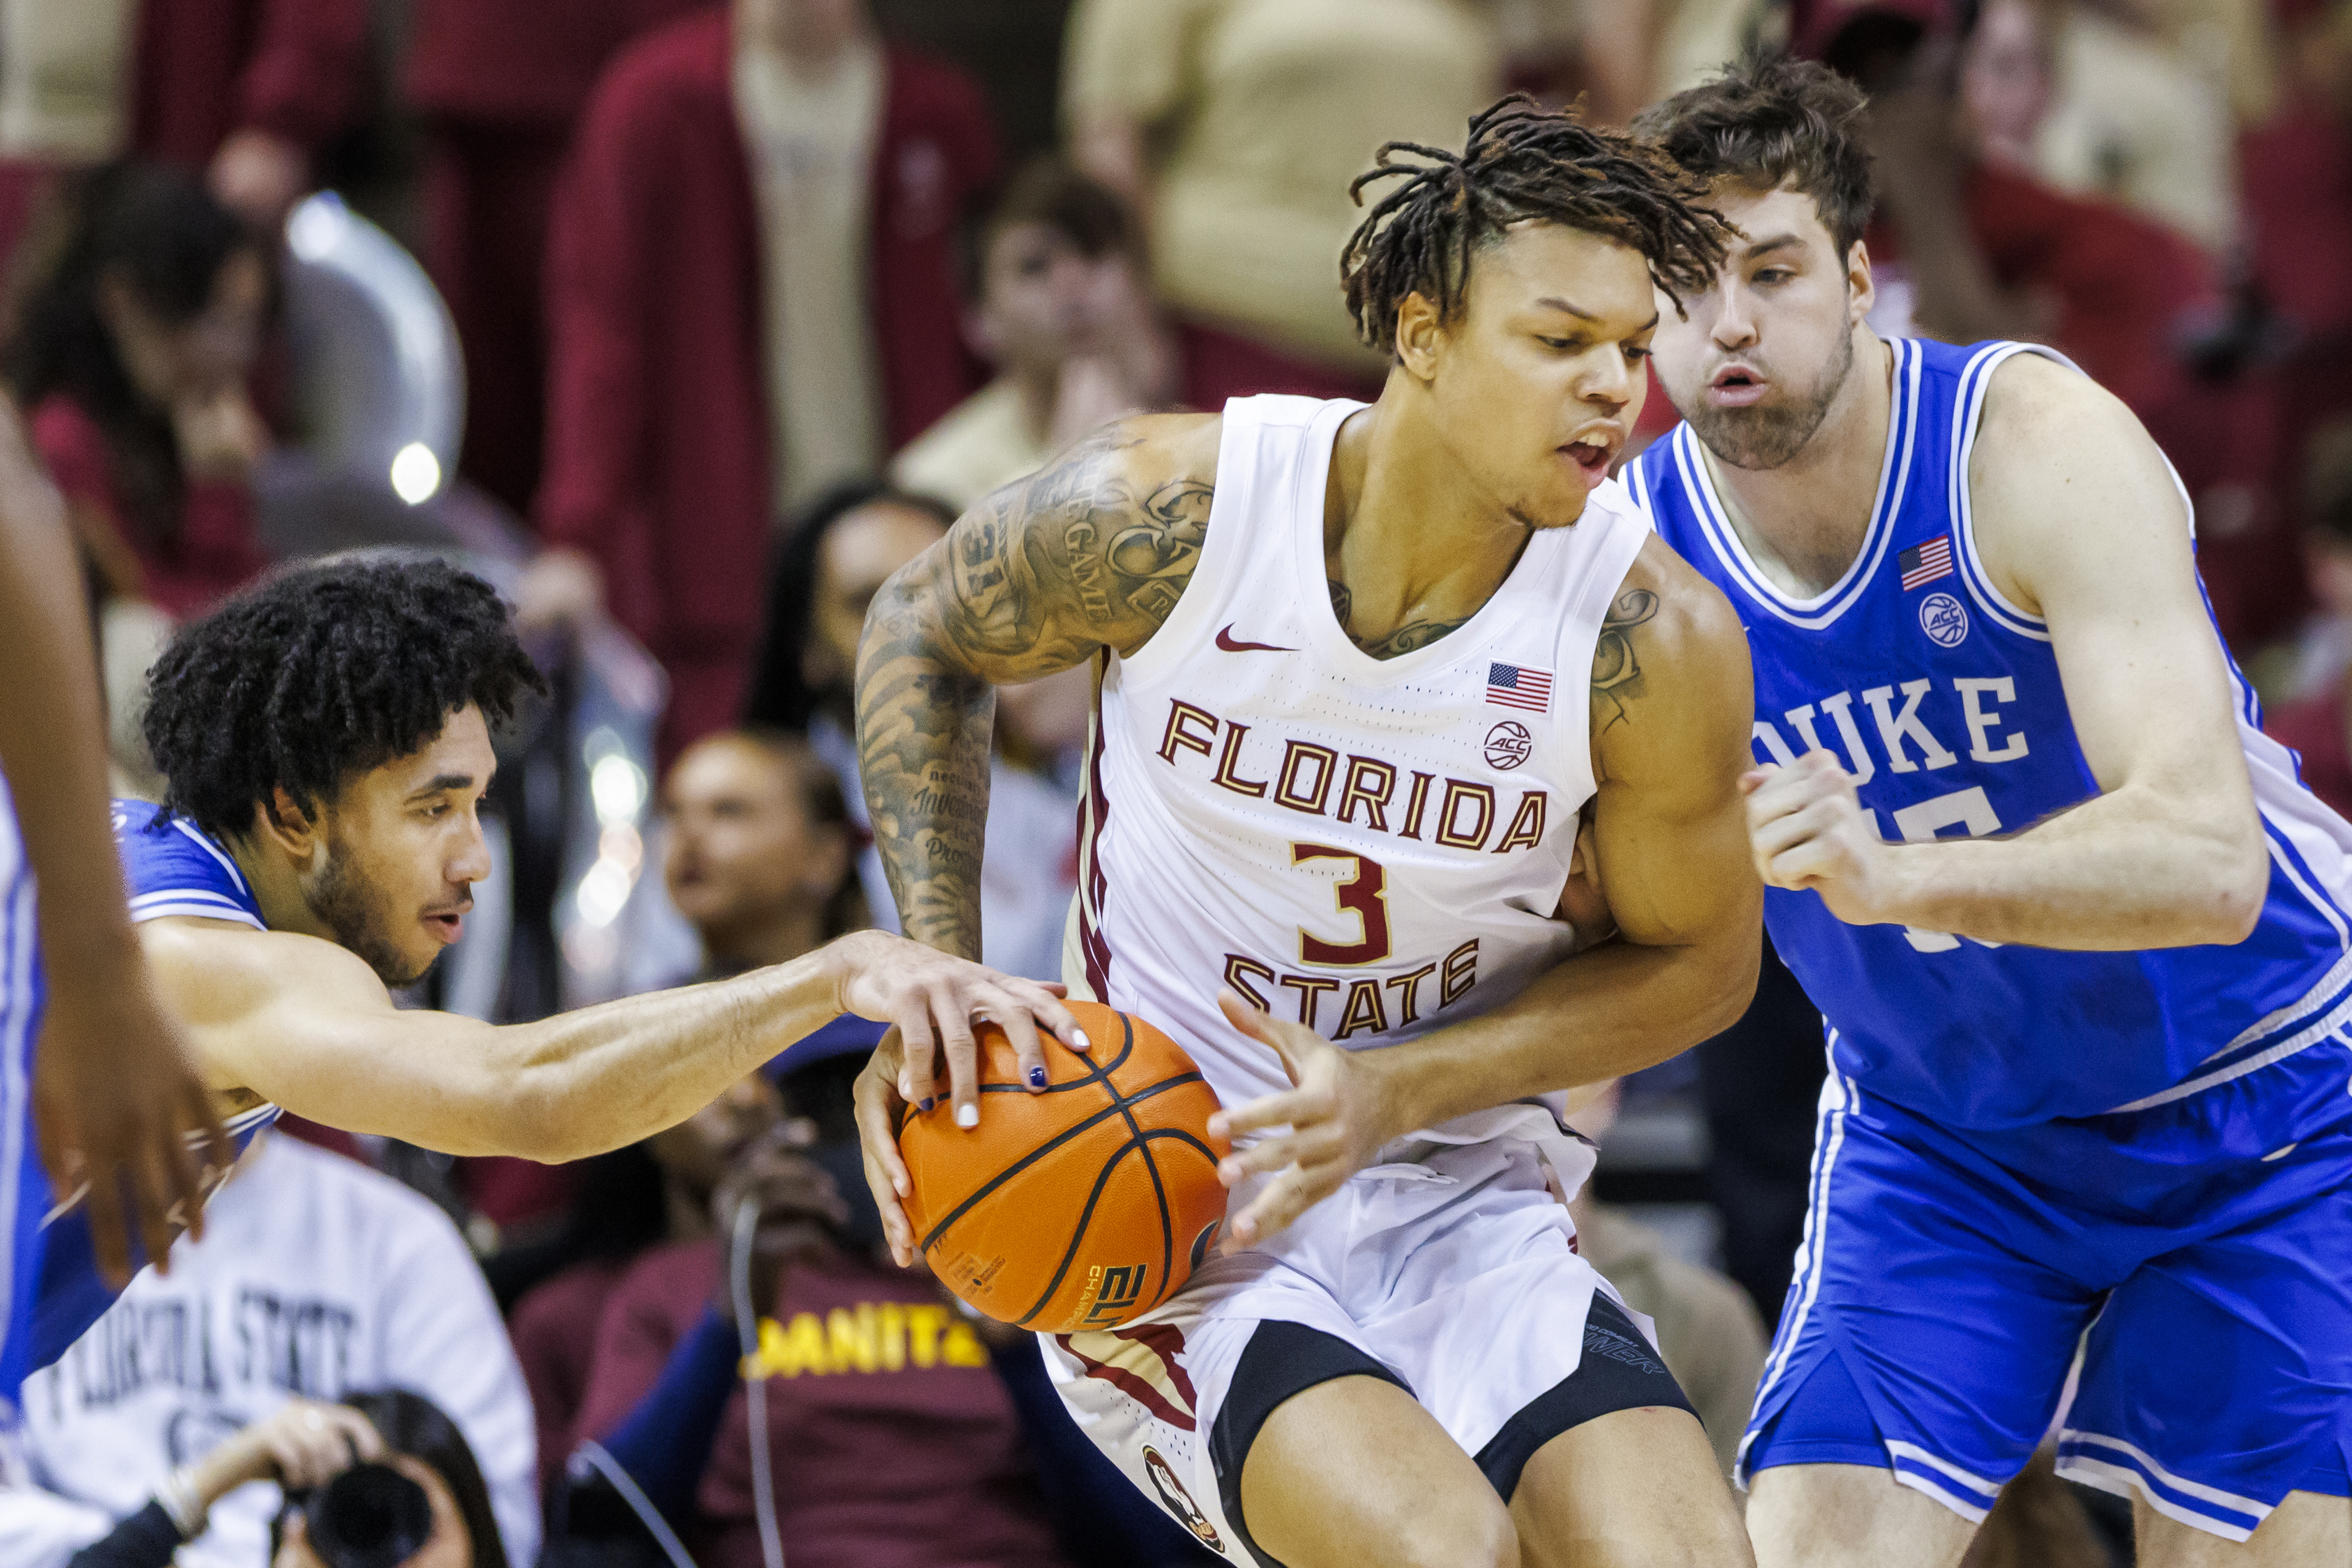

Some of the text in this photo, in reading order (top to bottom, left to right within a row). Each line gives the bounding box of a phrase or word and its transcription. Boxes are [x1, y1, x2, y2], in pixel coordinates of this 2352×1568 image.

[1931, 607, 1960, 625] ACC
[1155, 698, 1548, 854] FLORIDA
[1489, 738, 1530, 751] ACC
[1289, 840, 1393, 968] 3
[1224, 938, 1479, 1041] STATE
[1583, 1331, 1665, 1374] WER
